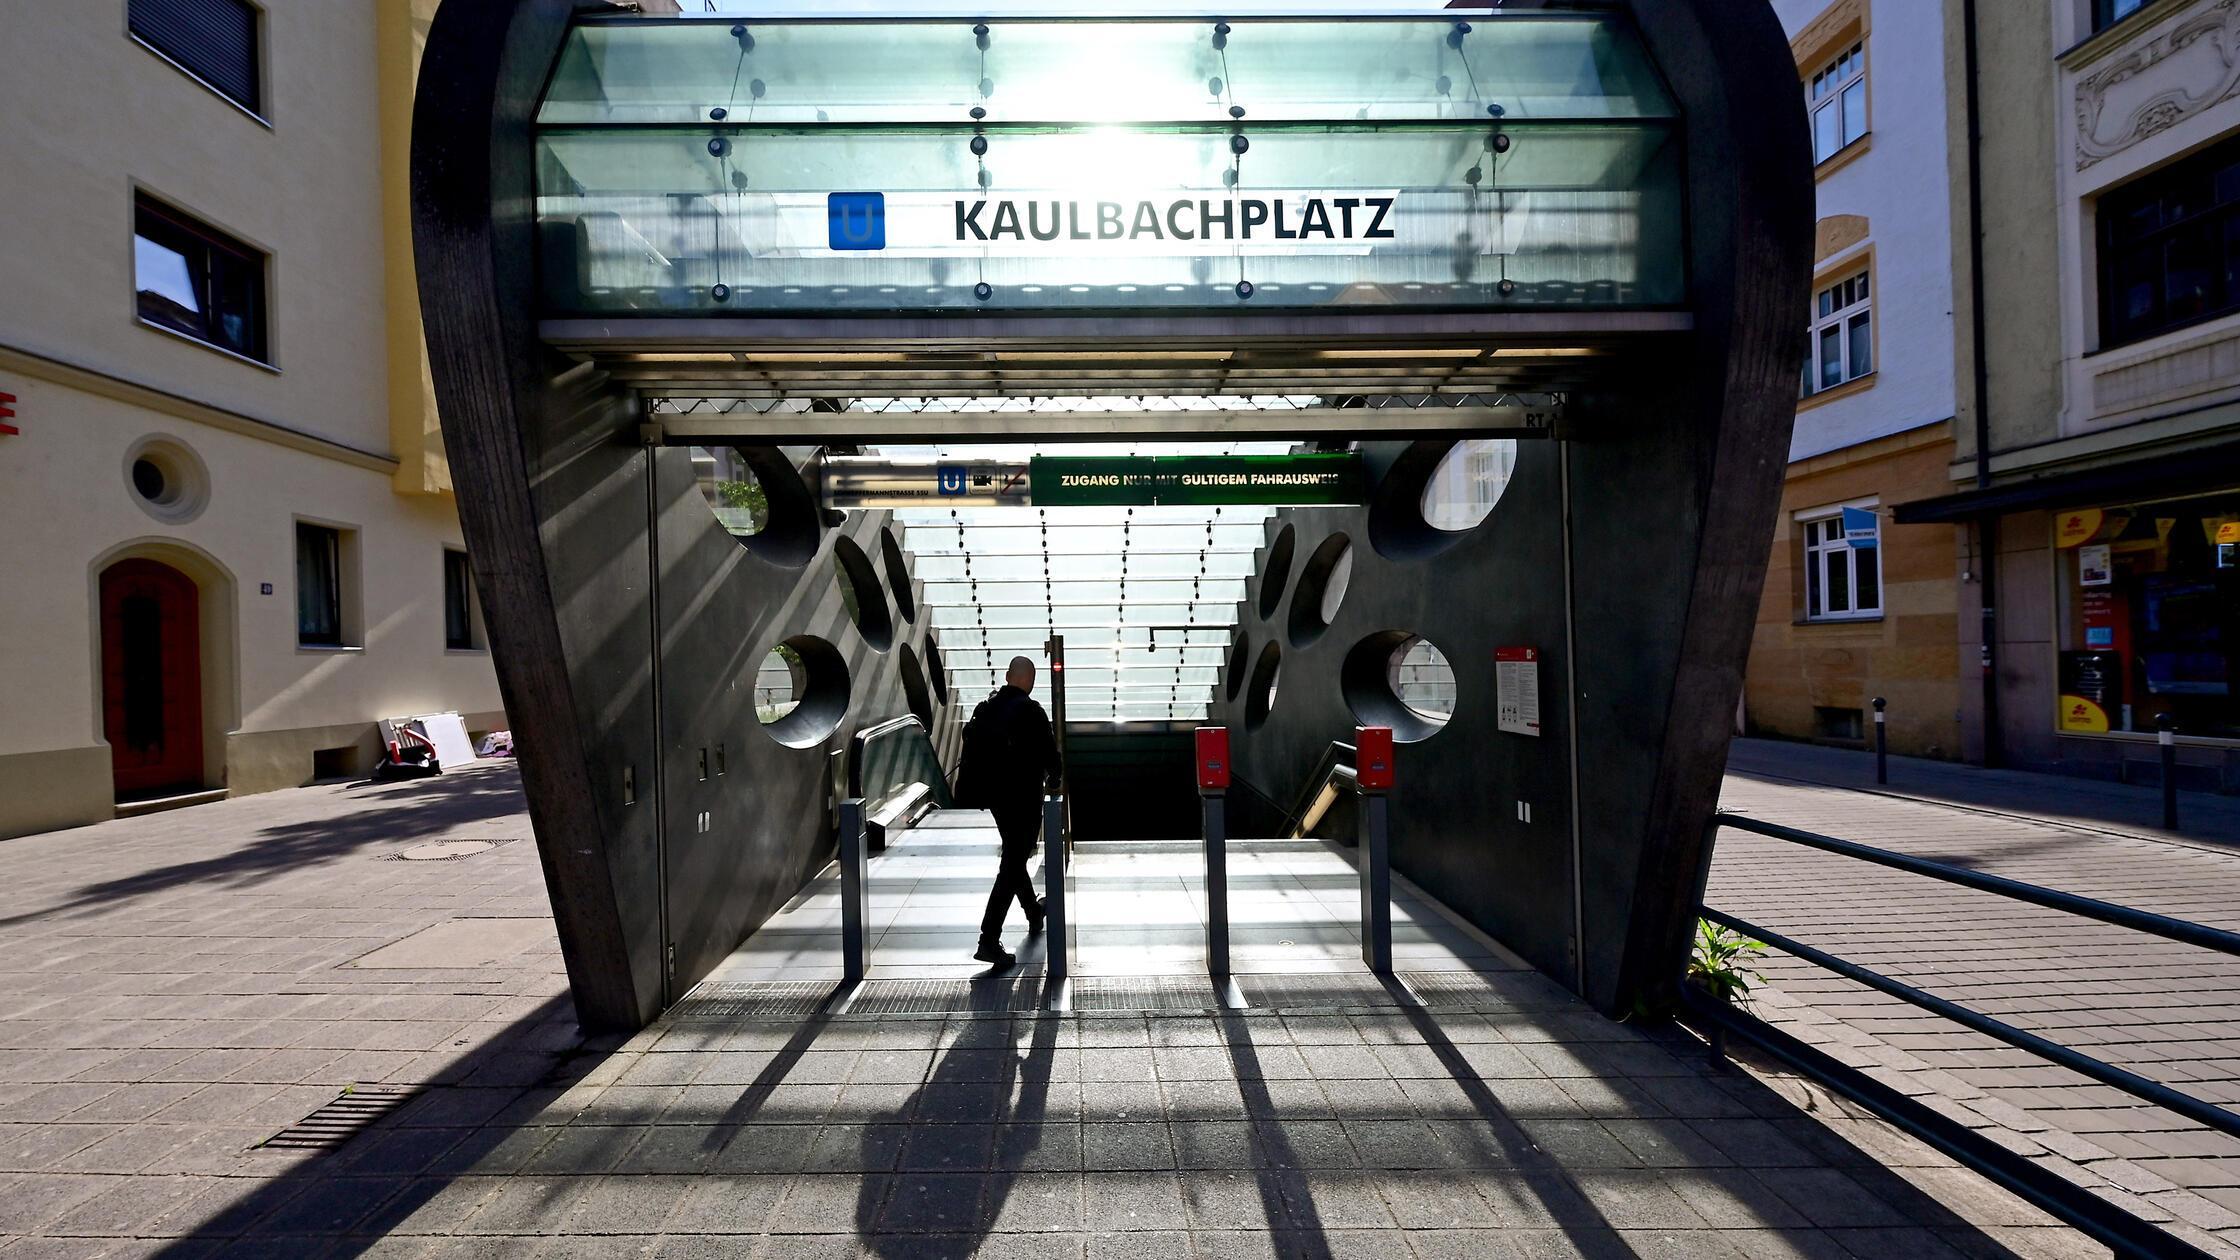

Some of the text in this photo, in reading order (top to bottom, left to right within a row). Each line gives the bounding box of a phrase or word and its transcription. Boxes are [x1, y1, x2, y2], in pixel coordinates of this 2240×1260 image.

[842, 203, 874, 243] U
[955, 198, 1396, 241] KAULBACHPLATZ
[943, 474, 960, 491] U
[1061, 472, 1340, 487] ZUGANG NUR MIT GÜLTIGEM FAHRAUSWEIS
